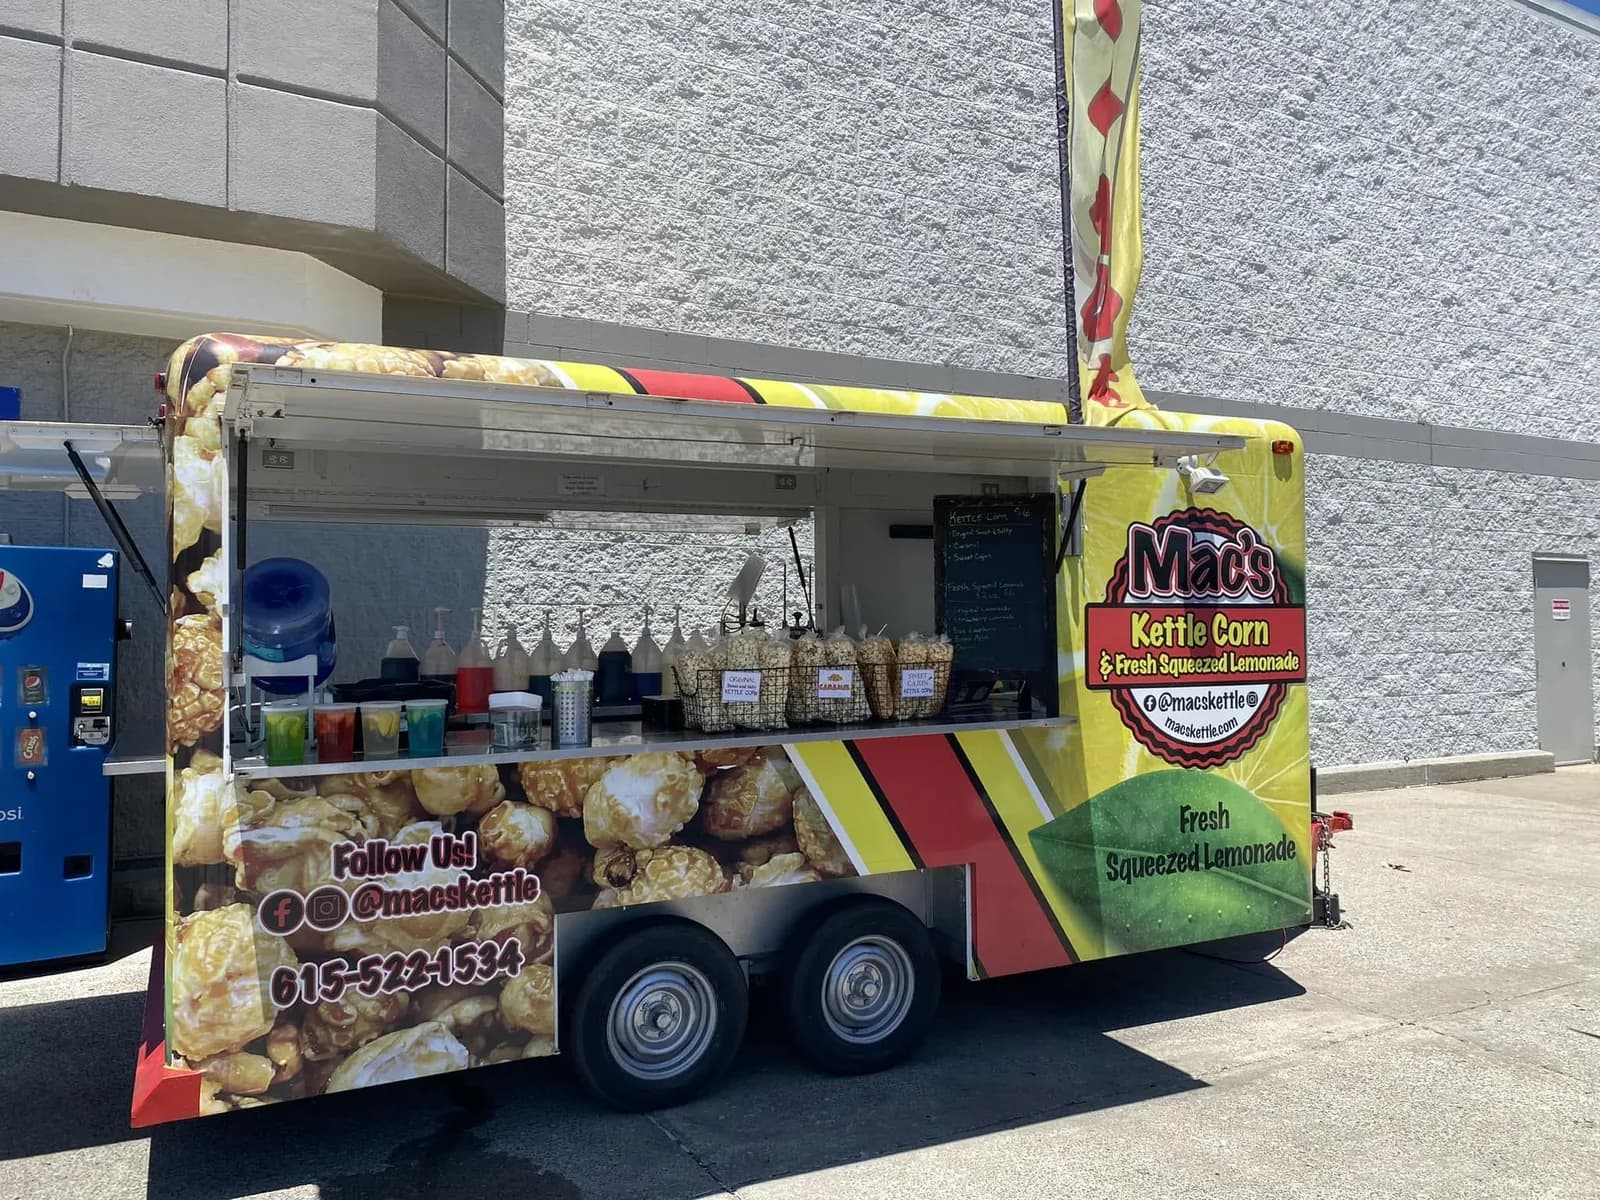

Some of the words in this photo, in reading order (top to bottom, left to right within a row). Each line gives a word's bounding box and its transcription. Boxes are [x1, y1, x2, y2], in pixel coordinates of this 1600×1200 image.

[1130, 525, 1275, 597] Mac's
[1131, 611, 1208, 648] Kettle
[1212, 613, 1269, 647] Corn
[1100, 651, 1113, 680] &
[1115, 654, 1157, 676] Fresh
[1160, 653, 1228, 679] Squeezed
[1230, 651, 1299, 673] Lemonade
[1158, 691, 1245, 712] @macskettle
[1165, 716, 1238, 740] macskettle.com
[1180, 801, 1230, 833] Fresh
[332, 840, 427, 880] Follow
[431, 832, 476, 869] Us!
[1106, 844, 1200, 885] Squeezed
[1204, 834, 1297, 870] Lemonade
[351, 869, 540, 921] @macskettle
[270, 938, 525, 1007] 615-522-1534
